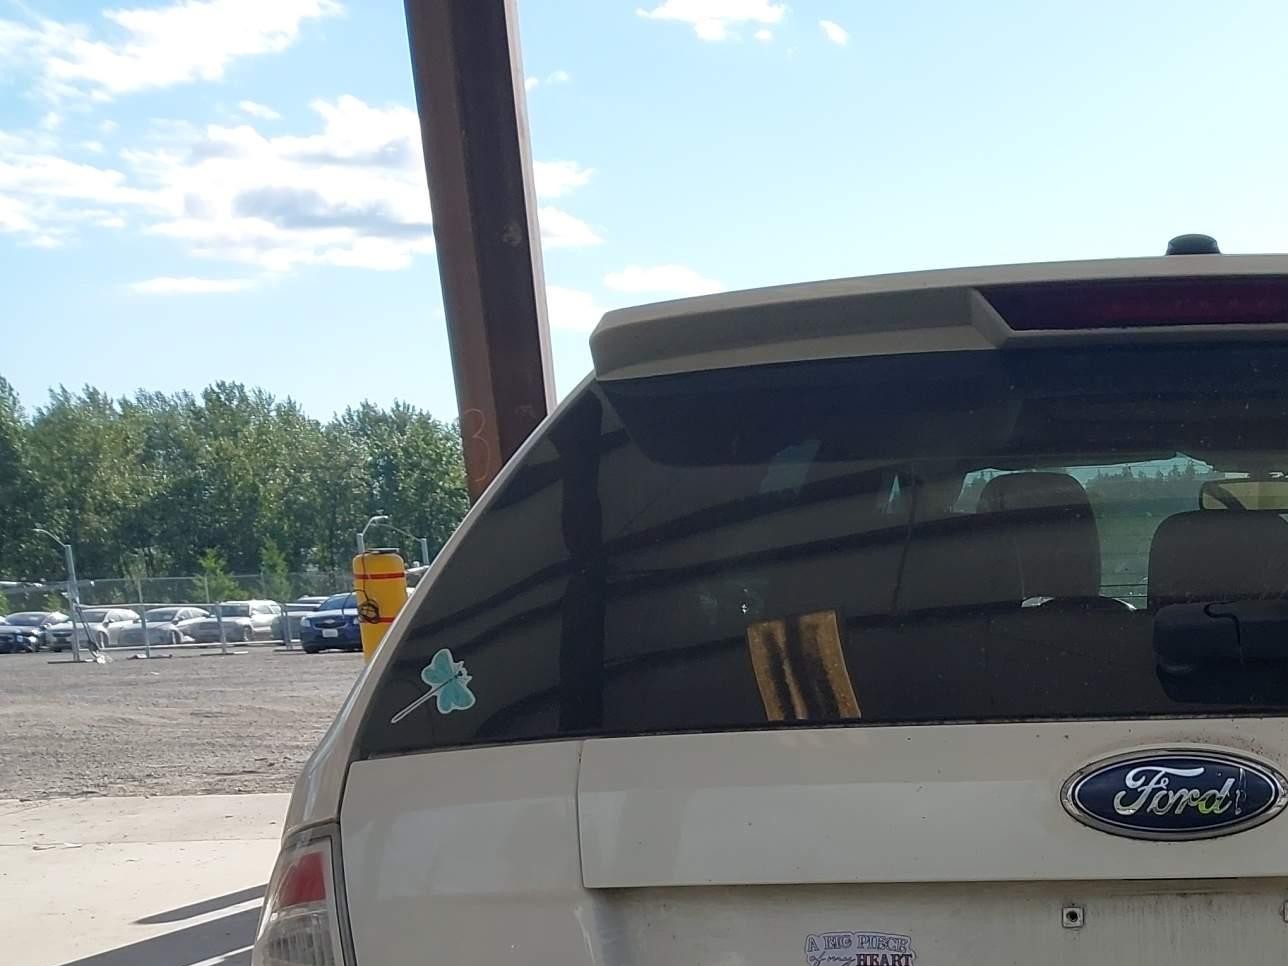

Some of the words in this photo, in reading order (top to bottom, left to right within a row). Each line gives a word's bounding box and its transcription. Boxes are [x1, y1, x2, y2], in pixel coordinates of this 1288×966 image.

[1113, 766, 1235, 815] Ford
[807, 936, 819, 952] A
[857, 935, 910, 953] PIECE
